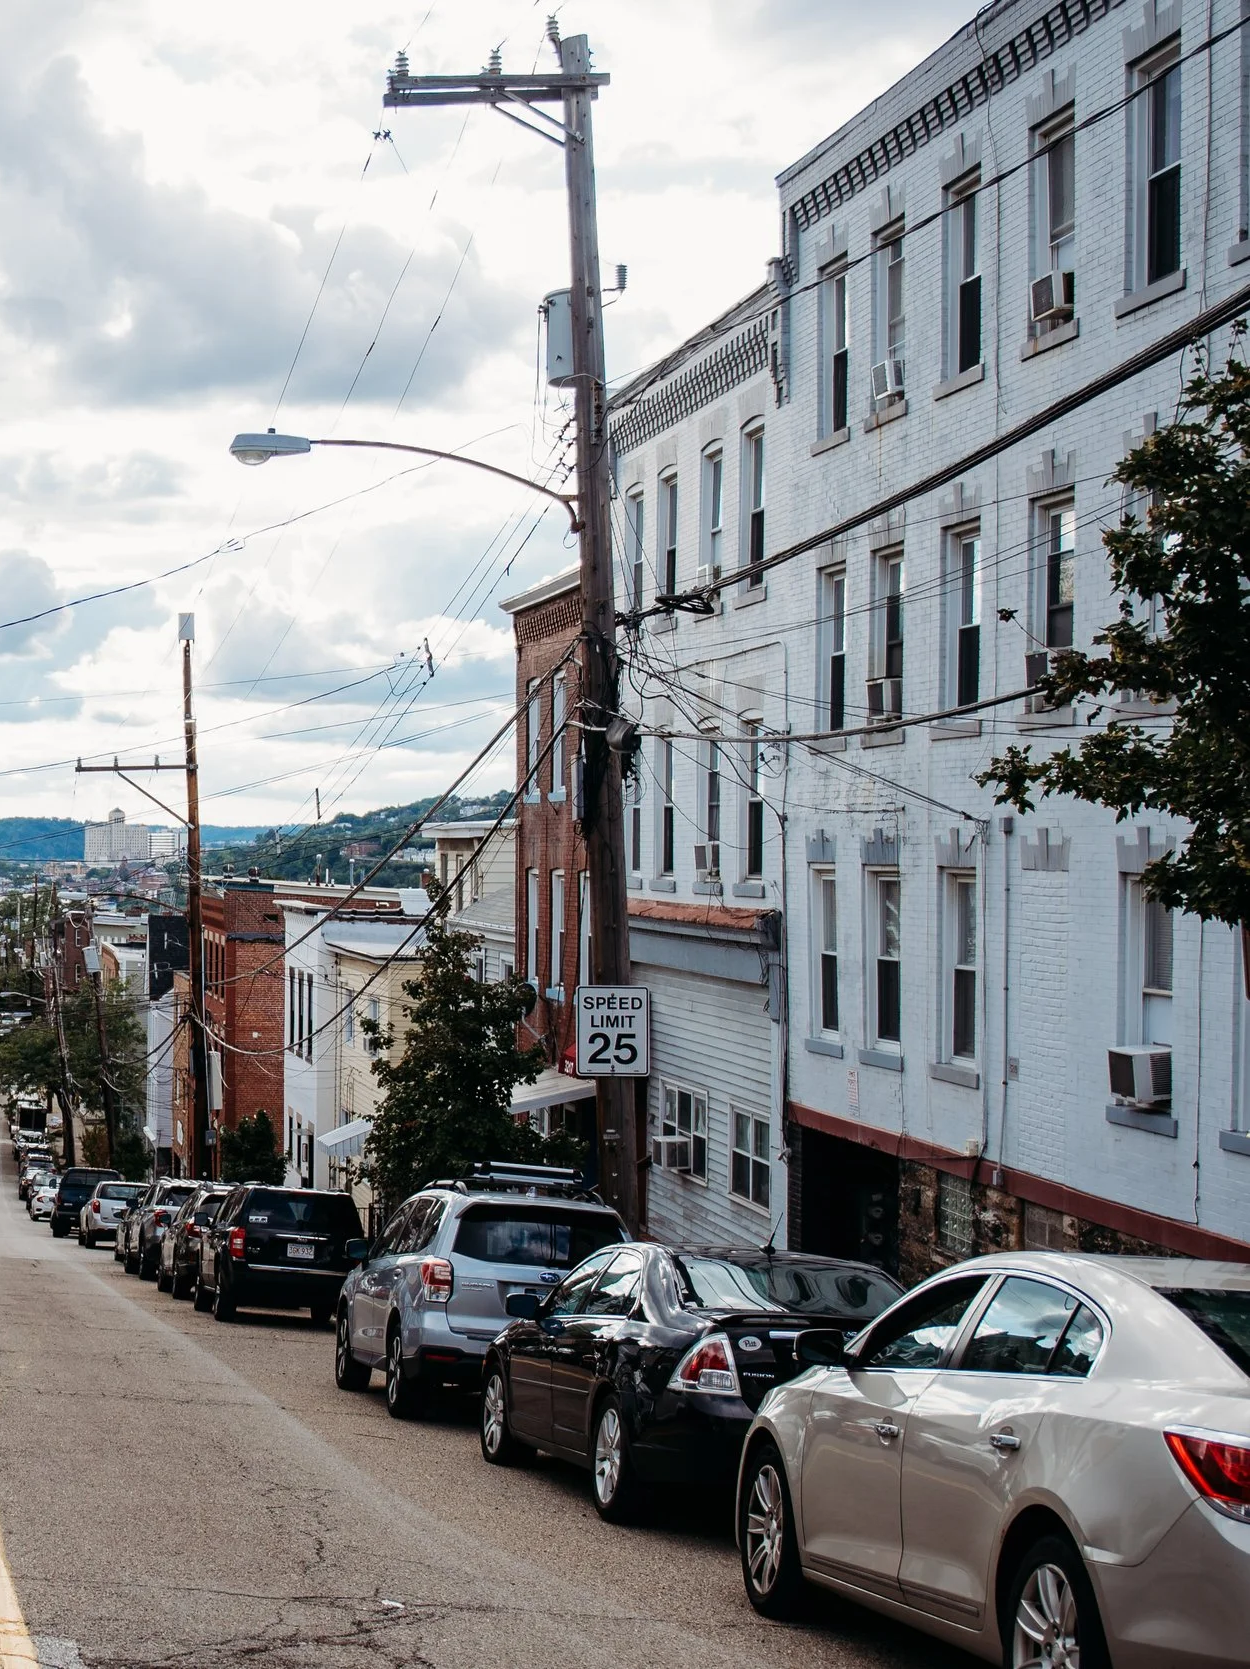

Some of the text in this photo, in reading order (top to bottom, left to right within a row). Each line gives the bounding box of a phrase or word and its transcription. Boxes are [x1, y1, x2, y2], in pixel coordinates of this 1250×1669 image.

[583, 996, 643, 1010] SPEED
[590, 1015, 636, 1028] LIMIT
[587, 1032, 638, 1065] 25
